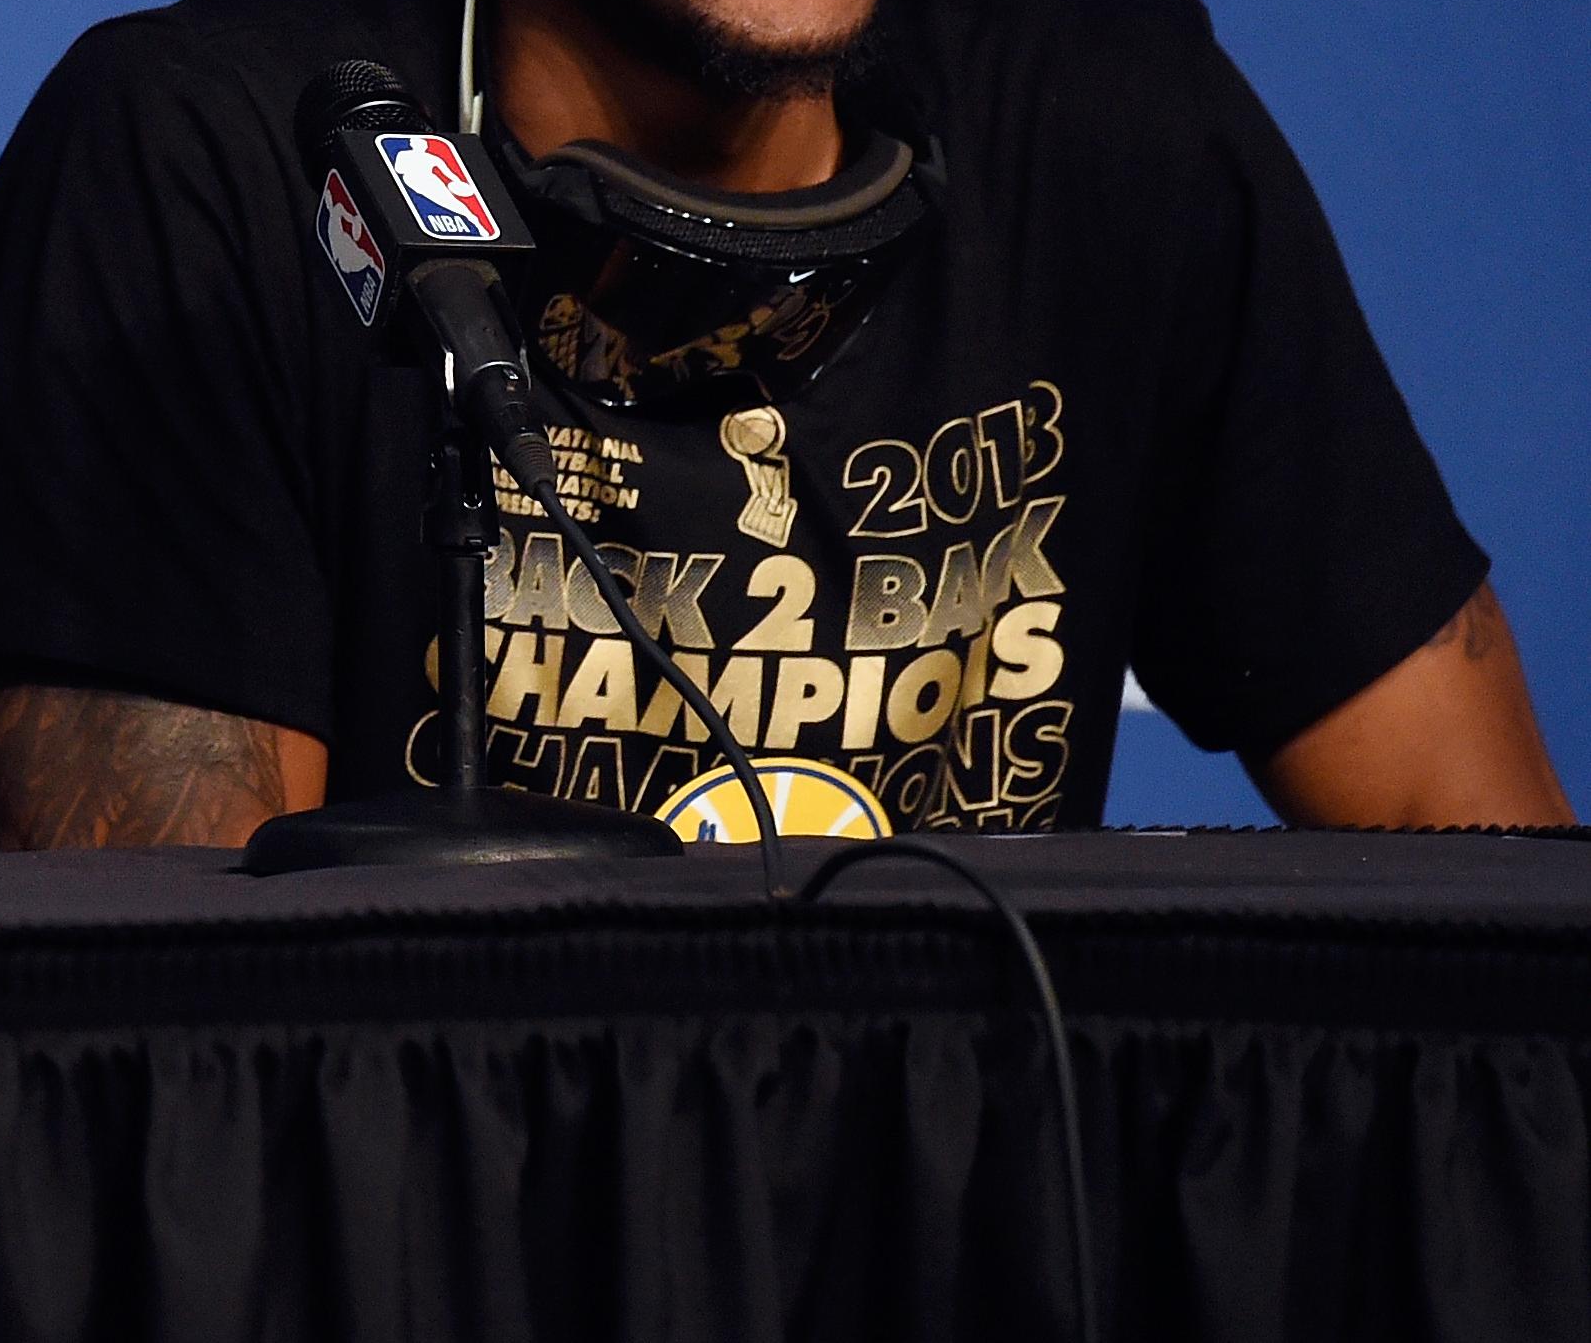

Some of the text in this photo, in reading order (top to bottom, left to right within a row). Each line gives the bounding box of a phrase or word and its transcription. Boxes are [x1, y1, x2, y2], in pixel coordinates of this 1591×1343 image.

[428, 214, 470, 234] NBA
[544, 424, 644, 464] ATINAL
[731, 554, 817, 652] 2
